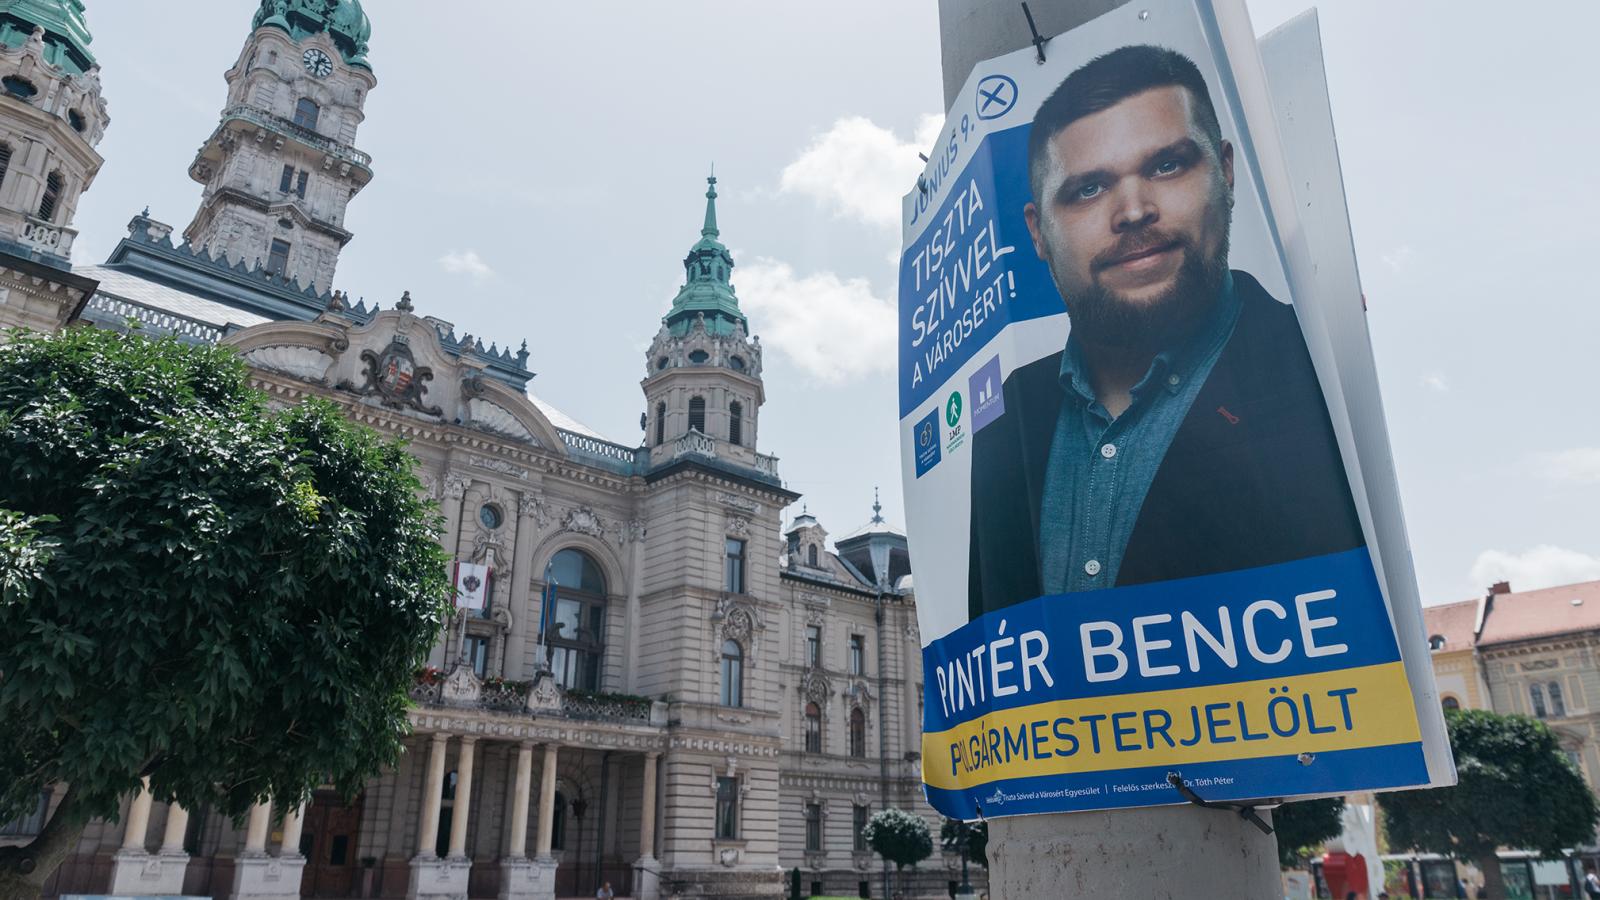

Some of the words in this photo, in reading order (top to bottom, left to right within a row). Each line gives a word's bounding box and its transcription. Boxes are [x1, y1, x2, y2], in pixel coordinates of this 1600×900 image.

[961, 114, 975, 142] 9.
[912, 178, 983, 291] TISZTA
[912, 219, 1015, 348] SZÍVVEL
[912, 361, 923, 389] A
[926, 270, 1016, 375] VÁROSÉRT!
[949, 425, 961, 440] LMP
[936, 619, 1054, 718] PINTÉR
[1079, 589, 1349, 683] BENCE
[1040, 789, 1065, 798] Városért
[1065, 786, 1100, 798] Egyesület
[1113, 783, 1140, 793] Felelős
[1184, 779, 1195, 788] Dr.
[1195, 777, 1213, 787] Tóth
[1214, 775, 1234, 785] Péter
